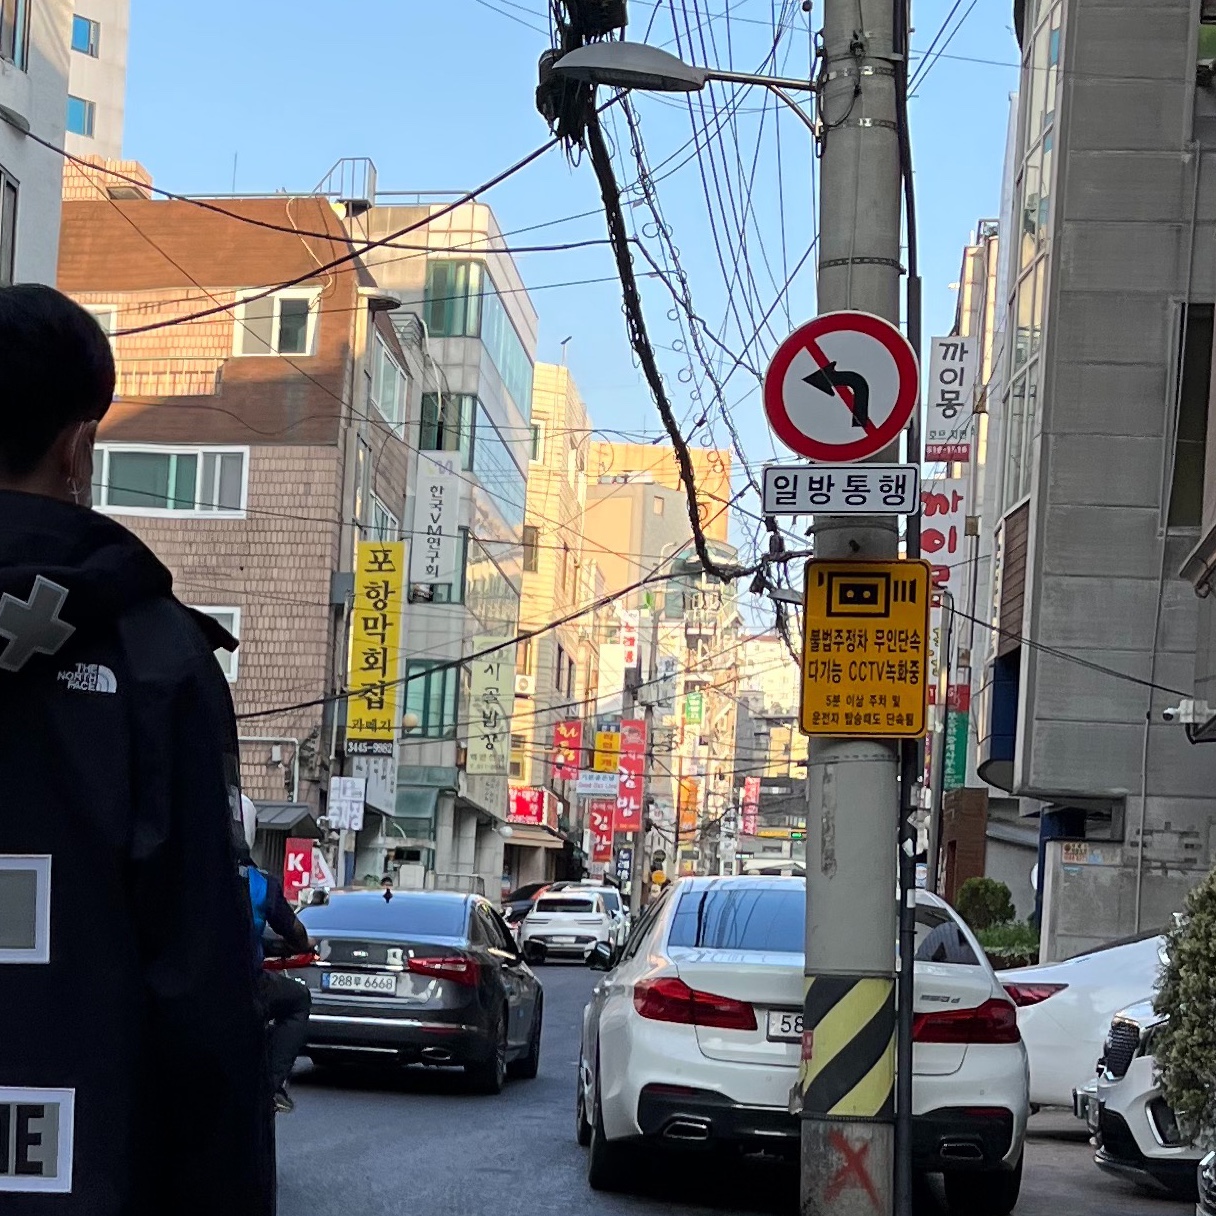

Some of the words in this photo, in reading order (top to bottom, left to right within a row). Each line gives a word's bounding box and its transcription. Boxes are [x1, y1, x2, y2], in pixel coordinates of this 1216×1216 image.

[936, 342, 968, 419] 까이몽
[774, 474, 906, 506] 일방통행
[359, 549, 396, 710] 포항막회집
[810, 629, 868, 653] 불법주정차
[874, 629, 921, 653] 무인단속
[75, 662, 98, 673] THE
[808, 658, 843, 684] 다기능
[849, 659, 920, 685] CCTV녹화중
[57, 670, 97, 684] NORTH
[67, 680, 95, 691] FACE
[825, 694, 840, 708] 5분
[846, 694, 864, 708] 이상
[869, 694, 886, 708] 주차
[812, 711, 840, 726] 운전자
[364, 977, 393, 990] 6668
